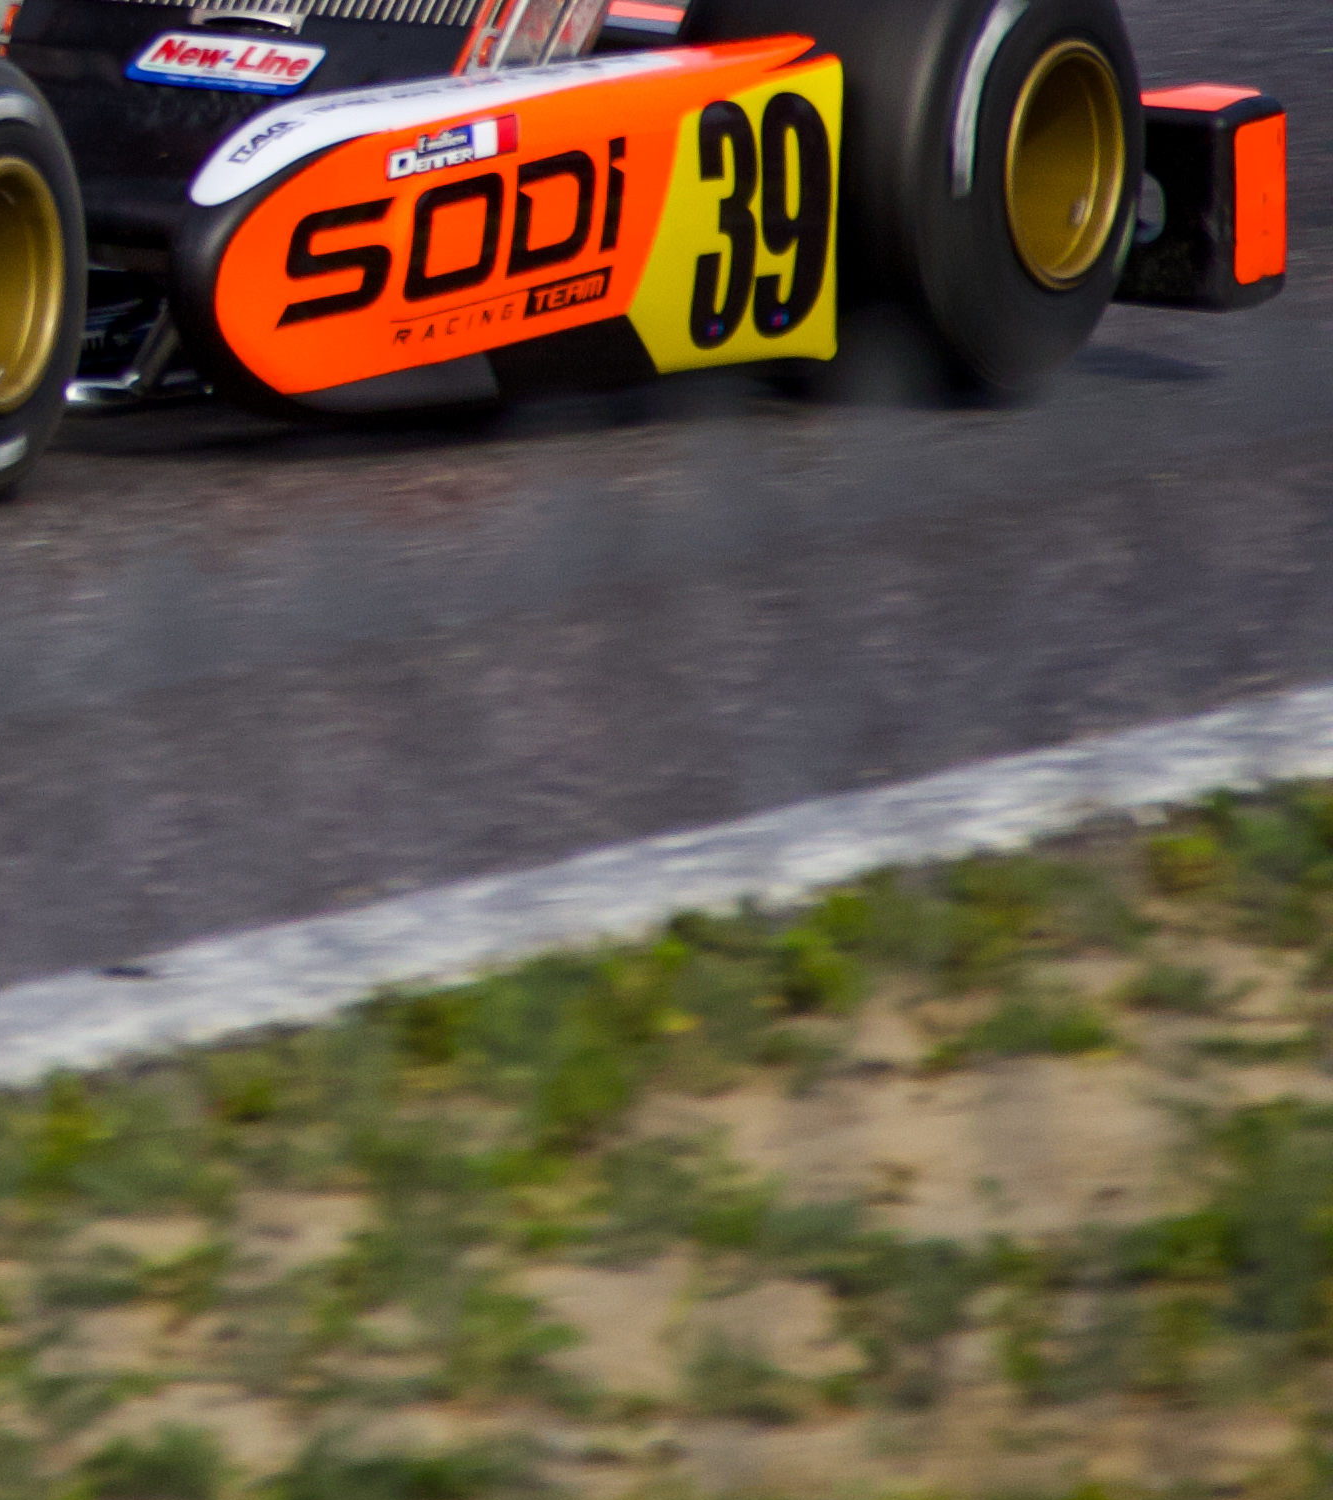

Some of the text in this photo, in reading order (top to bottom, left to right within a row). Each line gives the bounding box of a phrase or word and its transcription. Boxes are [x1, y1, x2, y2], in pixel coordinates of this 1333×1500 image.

[150, 38, 312, 77] New-Line
[688, 91, 832, 350] 39
[393, 272, 607, 347] RACING TEAM
